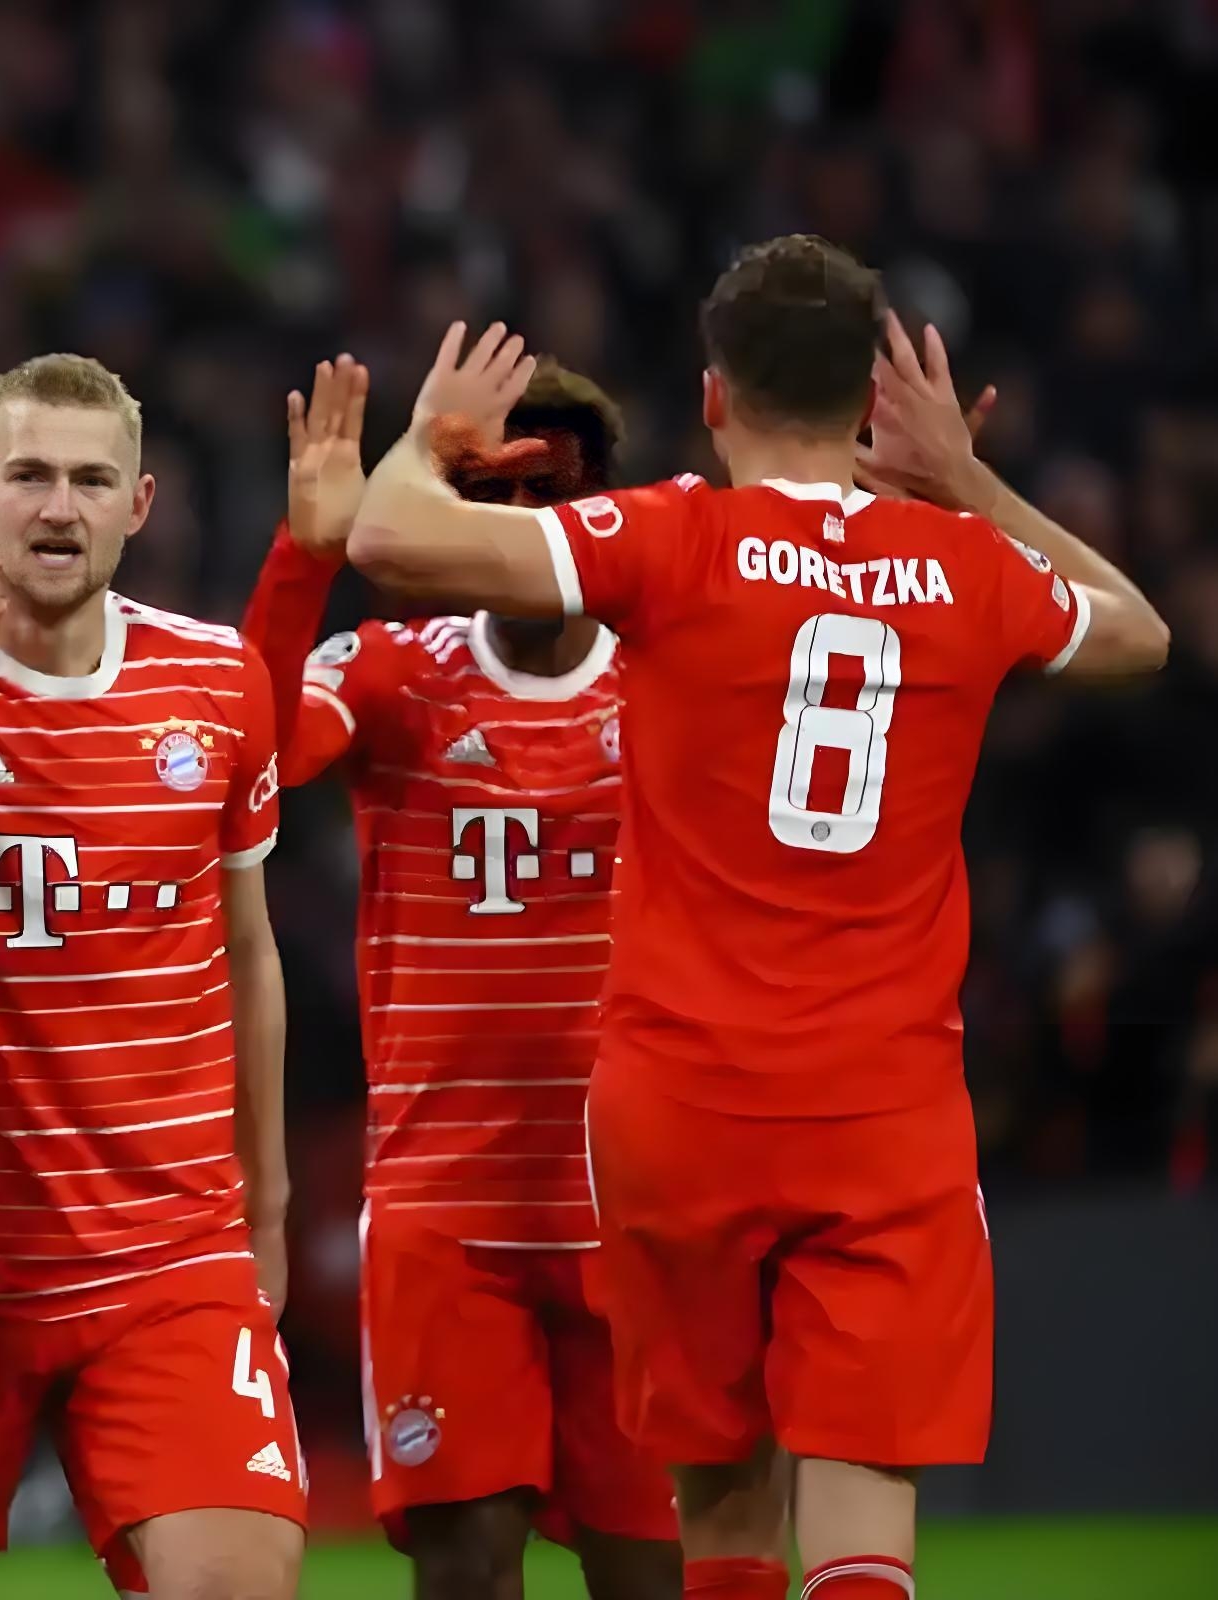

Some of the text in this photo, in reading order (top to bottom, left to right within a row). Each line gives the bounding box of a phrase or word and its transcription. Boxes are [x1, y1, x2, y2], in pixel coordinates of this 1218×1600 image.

[737, 536, 954, 606] GORETZKA
[768, 612, 902, 854] 8
[232, 1326, 275, 1419] 4
